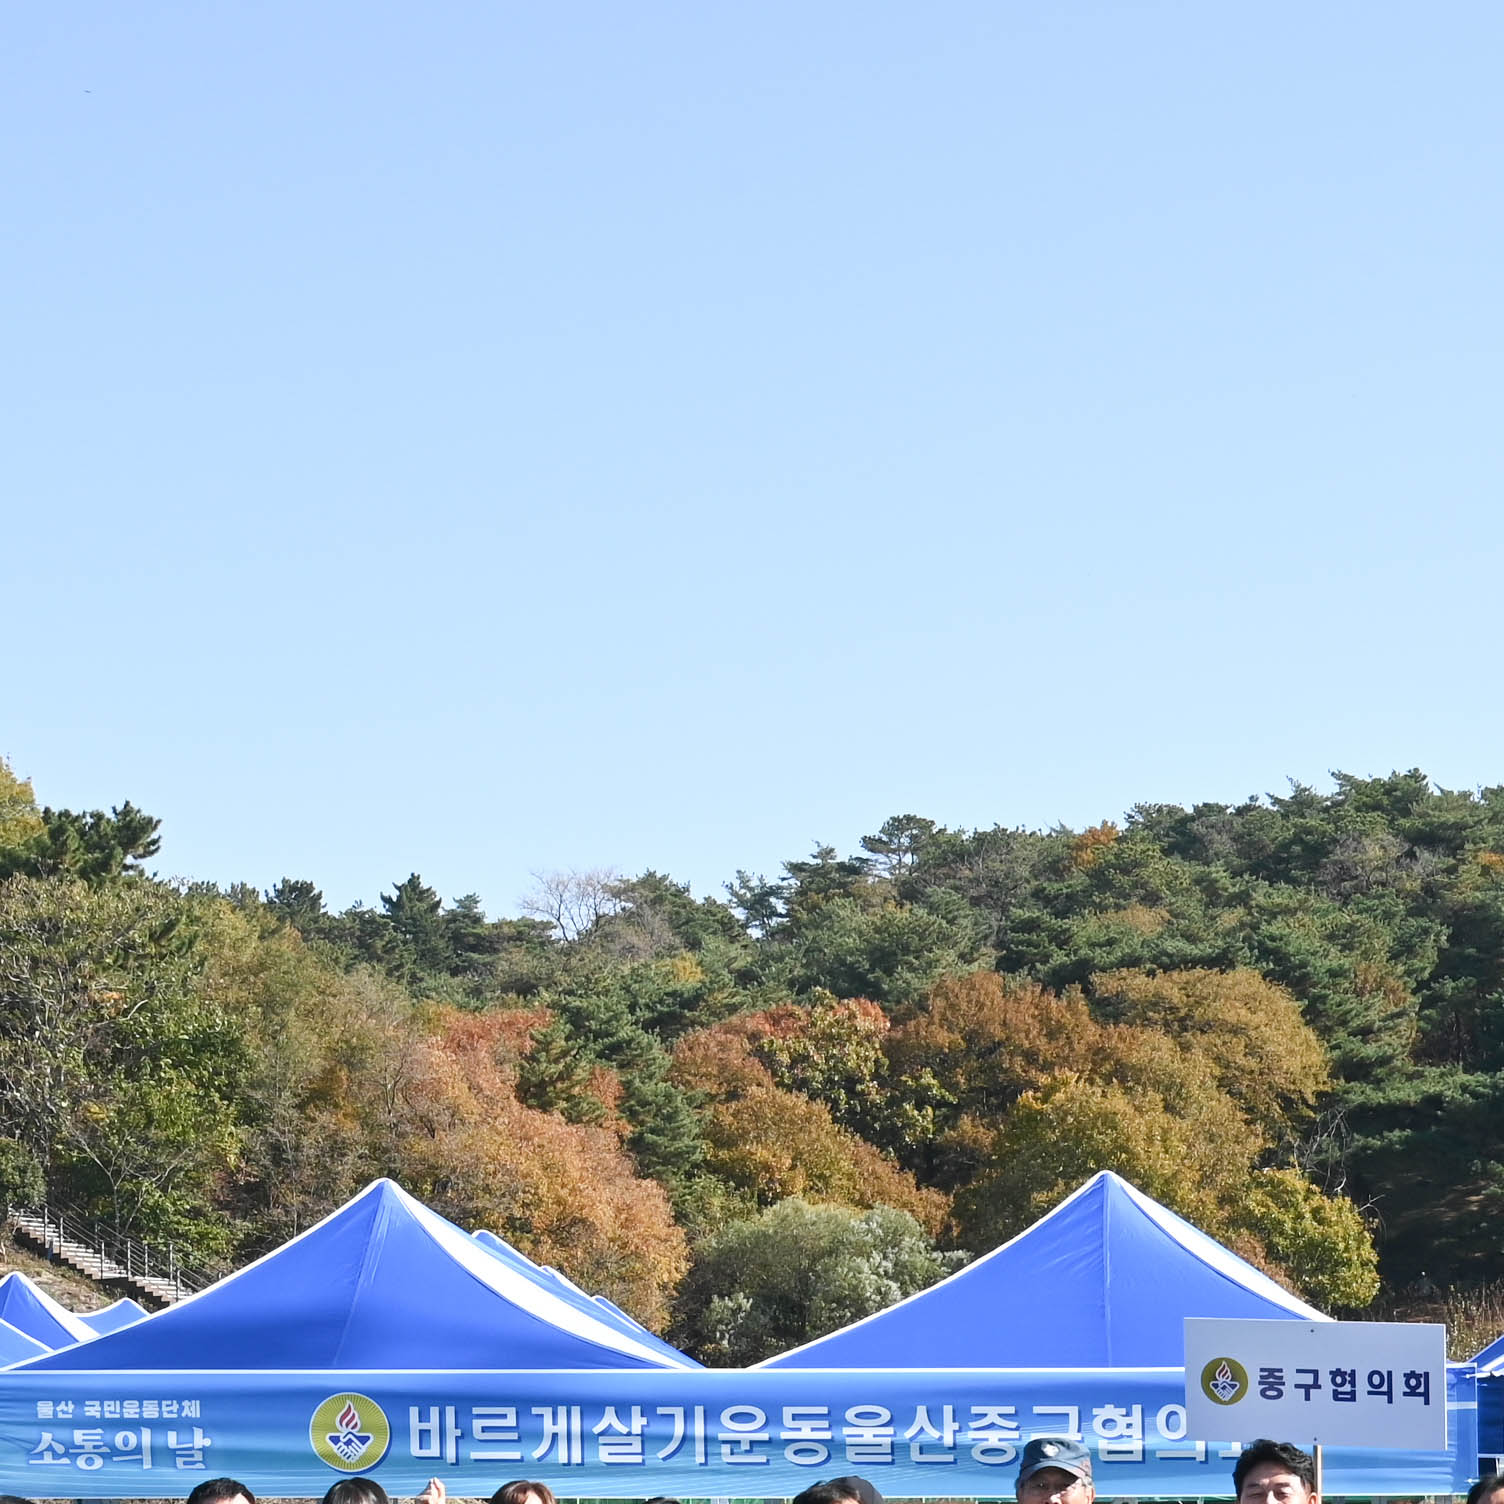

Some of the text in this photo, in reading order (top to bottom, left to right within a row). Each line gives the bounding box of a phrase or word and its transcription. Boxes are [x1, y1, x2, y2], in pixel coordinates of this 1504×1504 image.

[1257, 1367, 1431, 1406] 중구협의회
[37, 1400, 201, 1419] 울산 국민운동단체
[28, 1426, 212, 1471] 소통의 날
[409, 1402, 1242, 1465] 바르게살기운동울산중구협의
